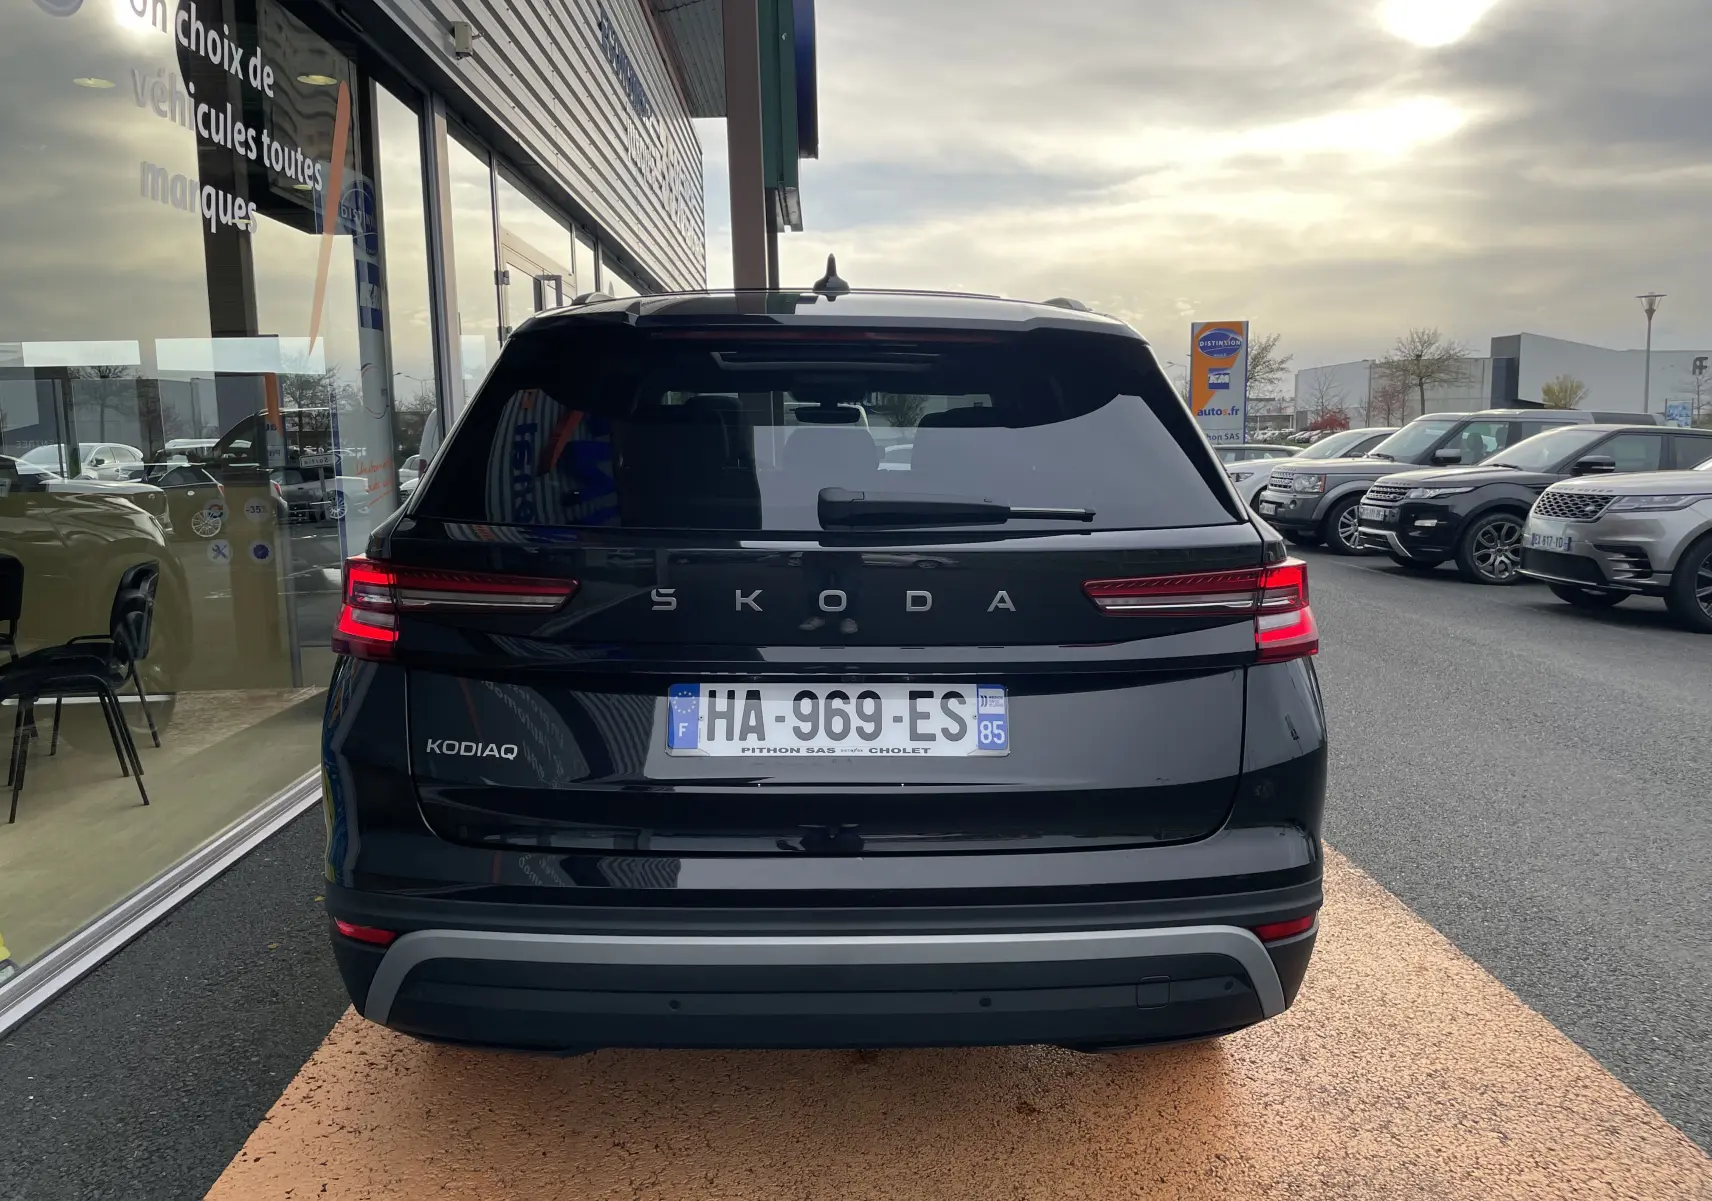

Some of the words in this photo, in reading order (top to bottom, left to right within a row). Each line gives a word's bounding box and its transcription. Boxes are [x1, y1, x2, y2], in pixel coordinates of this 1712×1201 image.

[176, 1, 243, 80] choix
[249, 46, 275, 98] de
[131, 67, 257, 160] véhicules
[262, 129, 322, 190] toutes
[140, 160, 257, 233] marques
[1200, 338, 1241, 347] DISTINXION
[1197, 405, 1240, 417] autos.fr
[1224, 433, 1240, 441] SAS
[651, 588, 1017, 612] SKODA
[706, 689, 968, 742] HA-969-ES
[678, 722, 688, 737] F
[980, 720, 1005, 744] 85
[426, 739, 518, 760] KODIAQ
